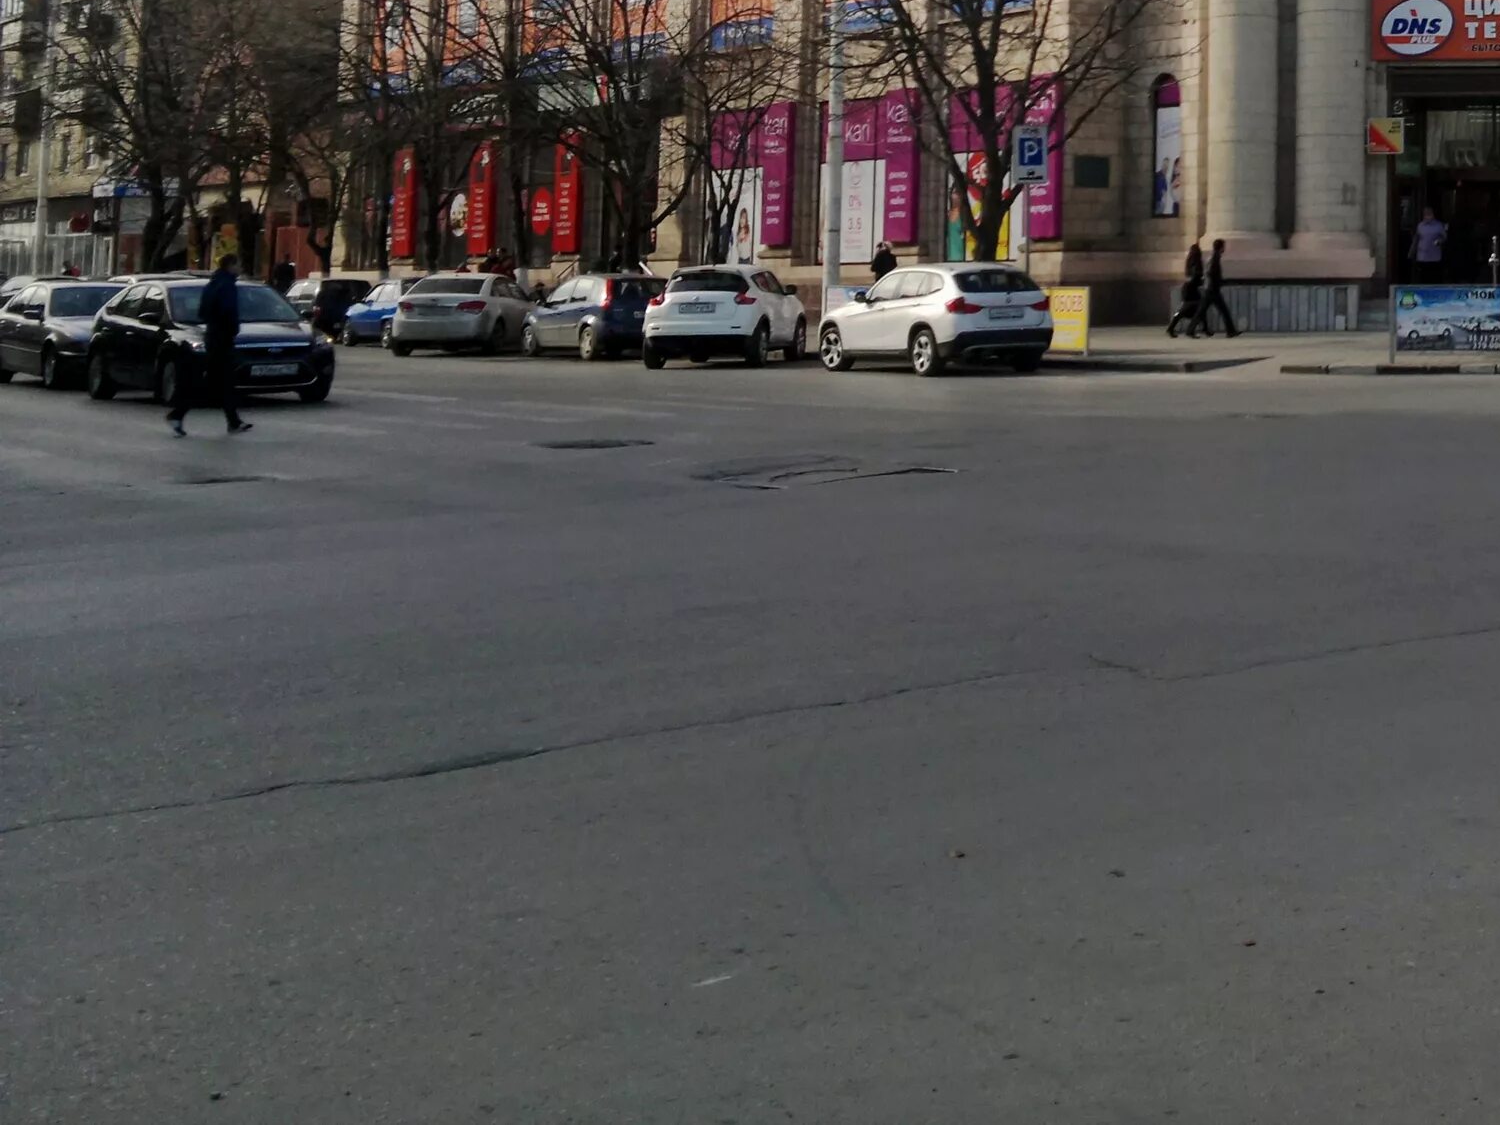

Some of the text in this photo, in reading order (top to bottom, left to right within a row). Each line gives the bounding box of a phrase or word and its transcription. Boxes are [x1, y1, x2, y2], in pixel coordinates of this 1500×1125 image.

[1390, 18, 1442, 35] DNS
[1409, 35, 1437, 44] PLUS
[844, 118, 871, 143] kari
[1023, 139, 1039, 164] P
